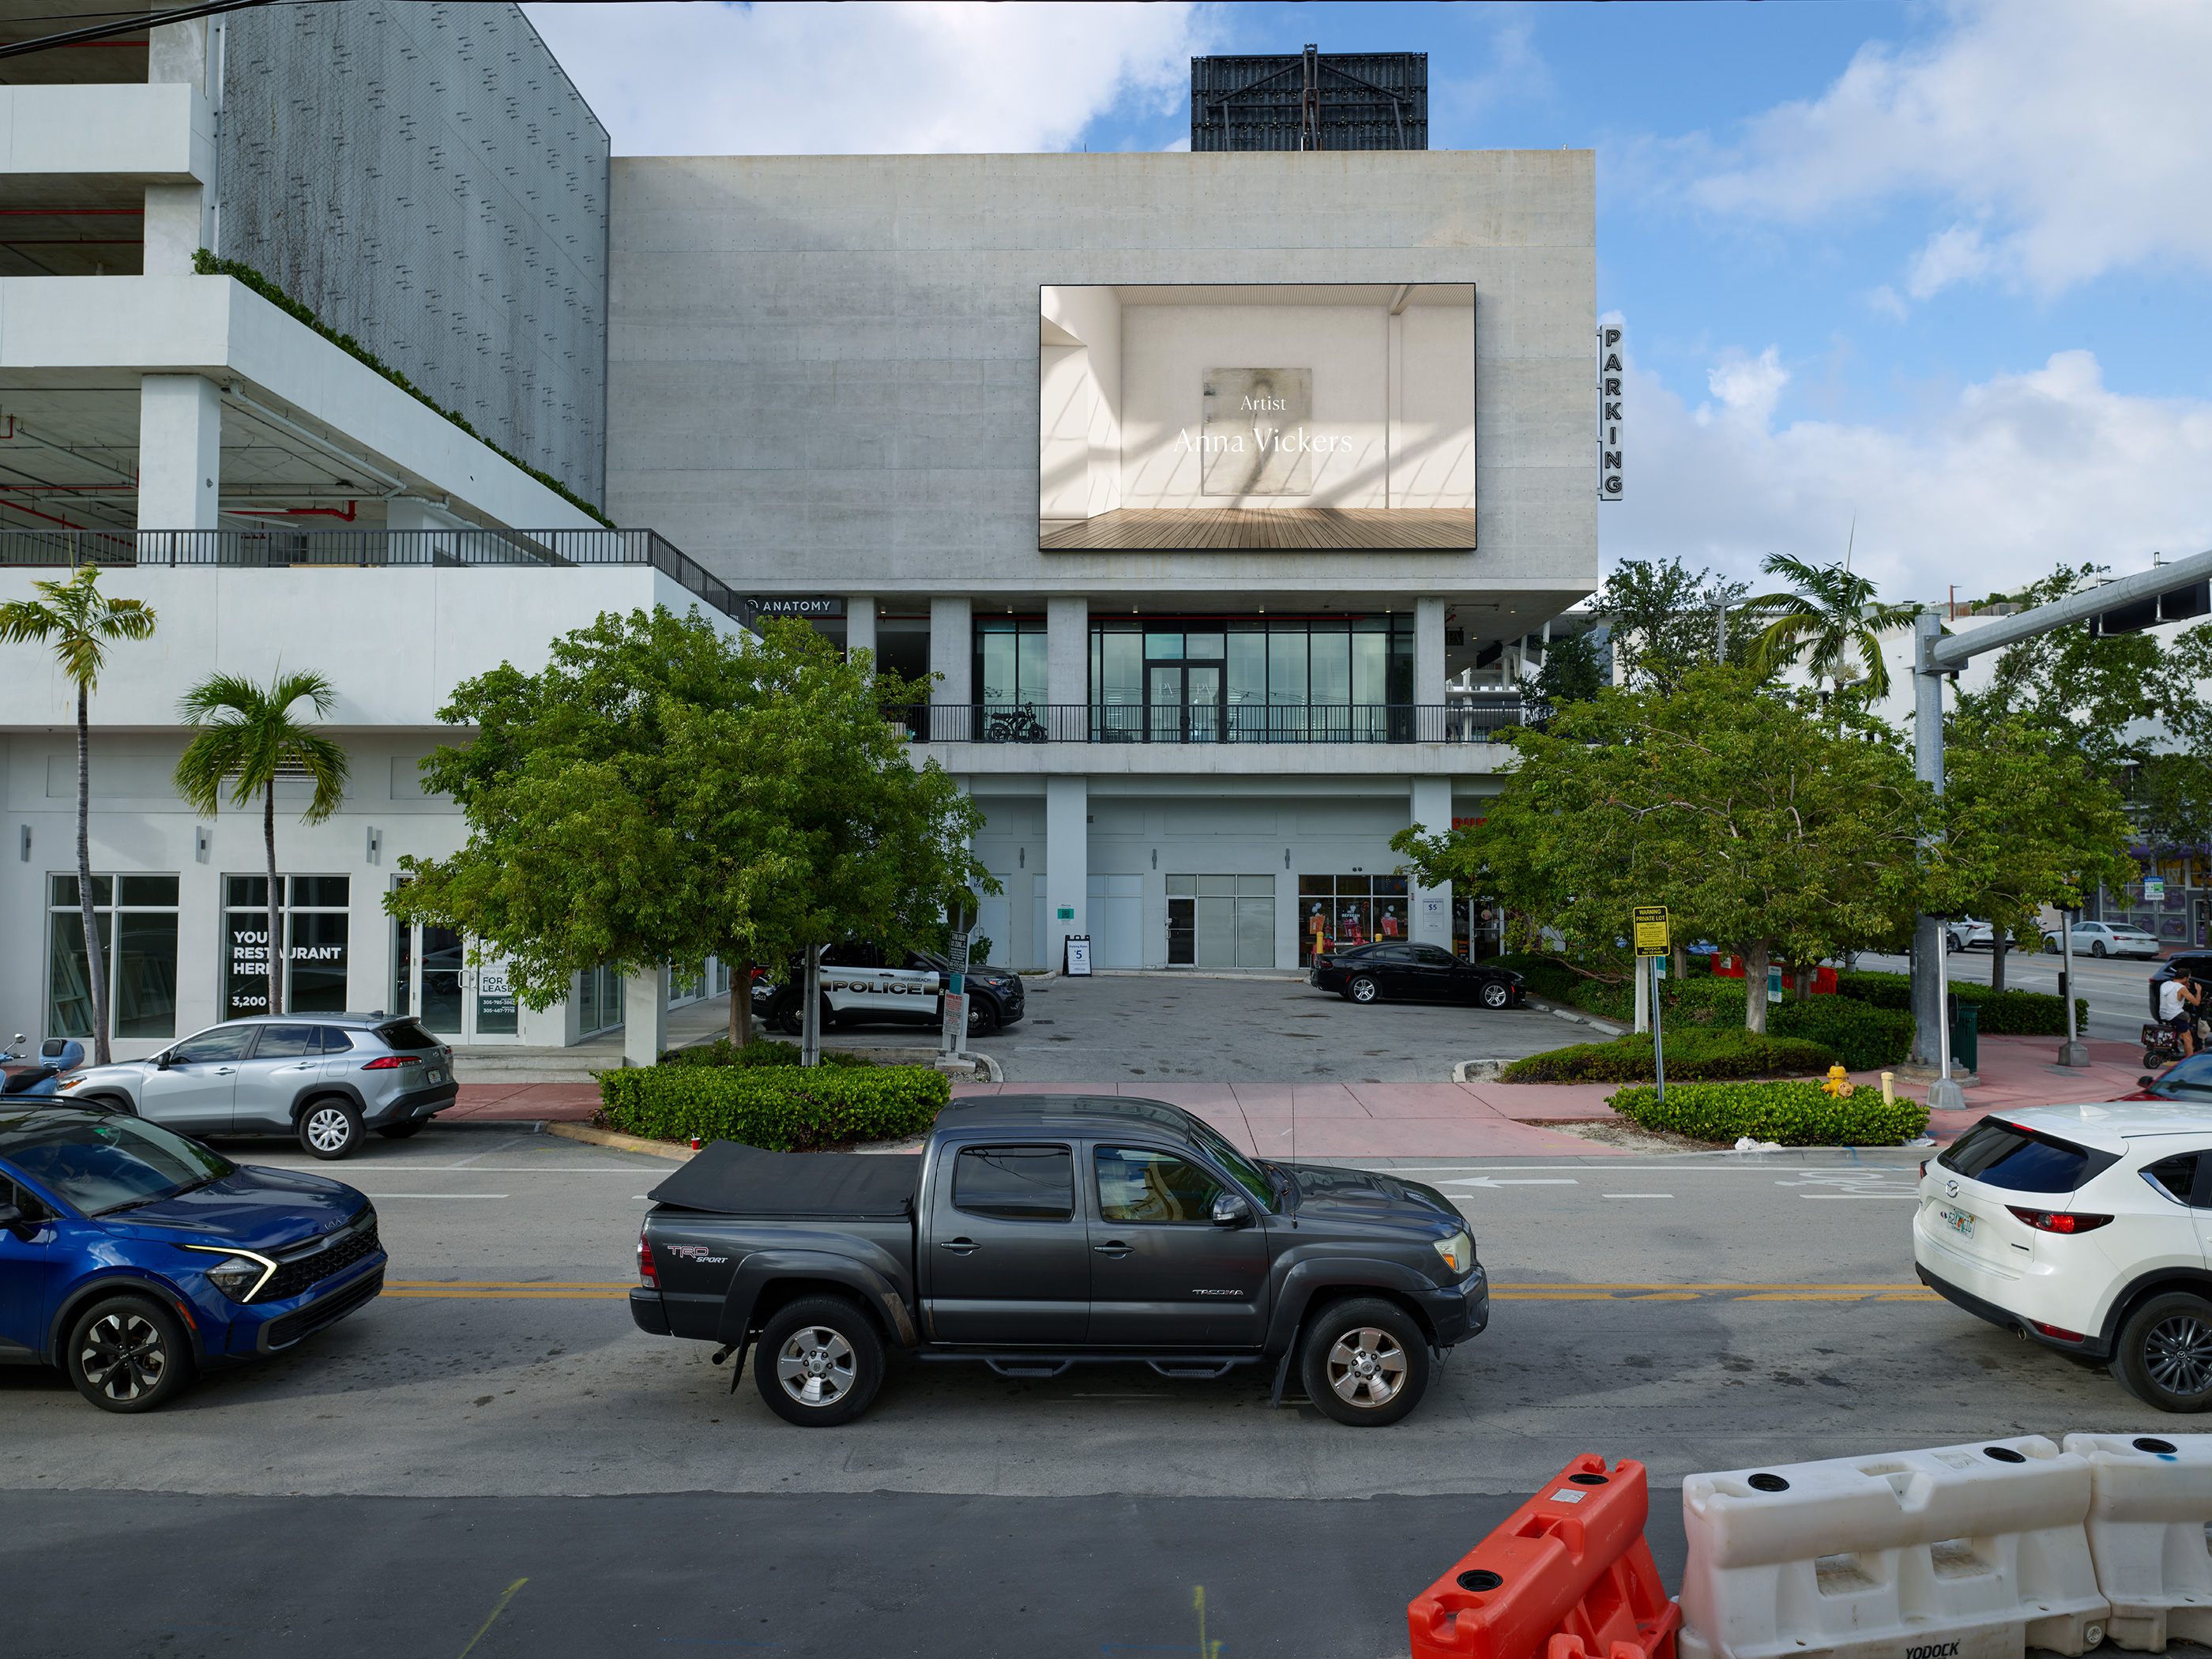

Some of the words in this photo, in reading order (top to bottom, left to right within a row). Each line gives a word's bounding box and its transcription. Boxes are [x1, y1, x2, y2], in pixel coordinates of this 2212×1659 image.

[1240, 395, 1287, 411] Artist
[1604, 329, 1622, 494] PARKING
[1173, 427, 1245, 453] Anna
[1252, 427, 1352, 453] Vickers
[762, 601, 830, 611] ANATOMY
[233, 931, 269, 944] YOU
[833, 980, 922, 995] POLICE
[231, 996, 267, 1008] 3,200
[667, 1245, 709, 1258] TRD
[1905, 1642, 1960, 1659] YODOCK
